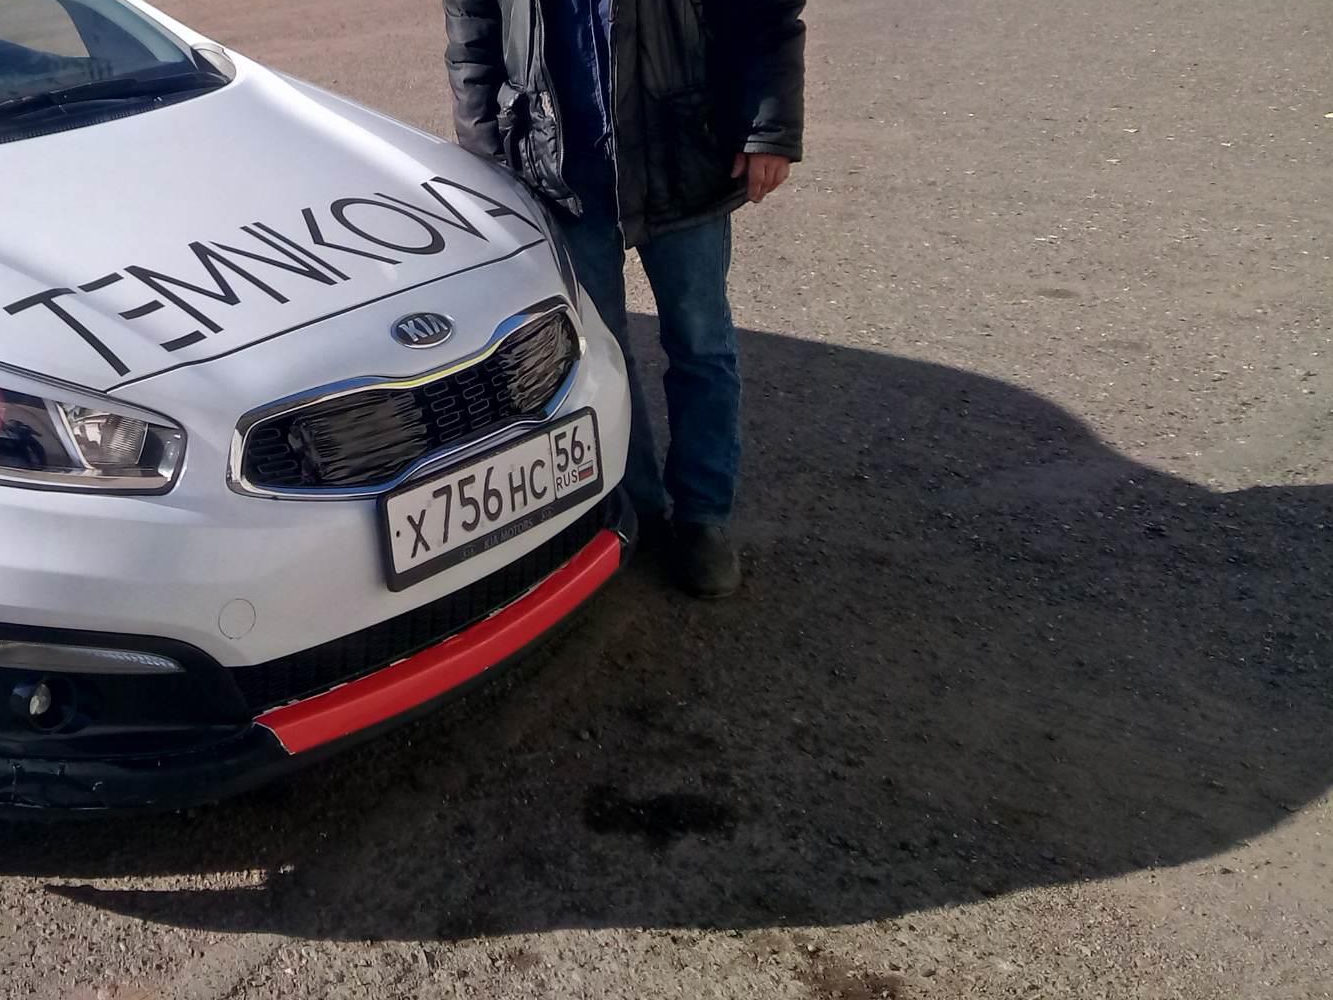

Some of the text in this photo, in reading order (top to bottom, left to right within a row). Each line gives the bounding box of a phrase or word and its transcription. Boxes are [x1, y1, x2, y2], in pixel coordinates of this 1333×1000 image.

[398, 314, 449, 342] KIA
[407, 425, 585, 559] Х756НС 56
[555, 468, 579, 492] RUS
